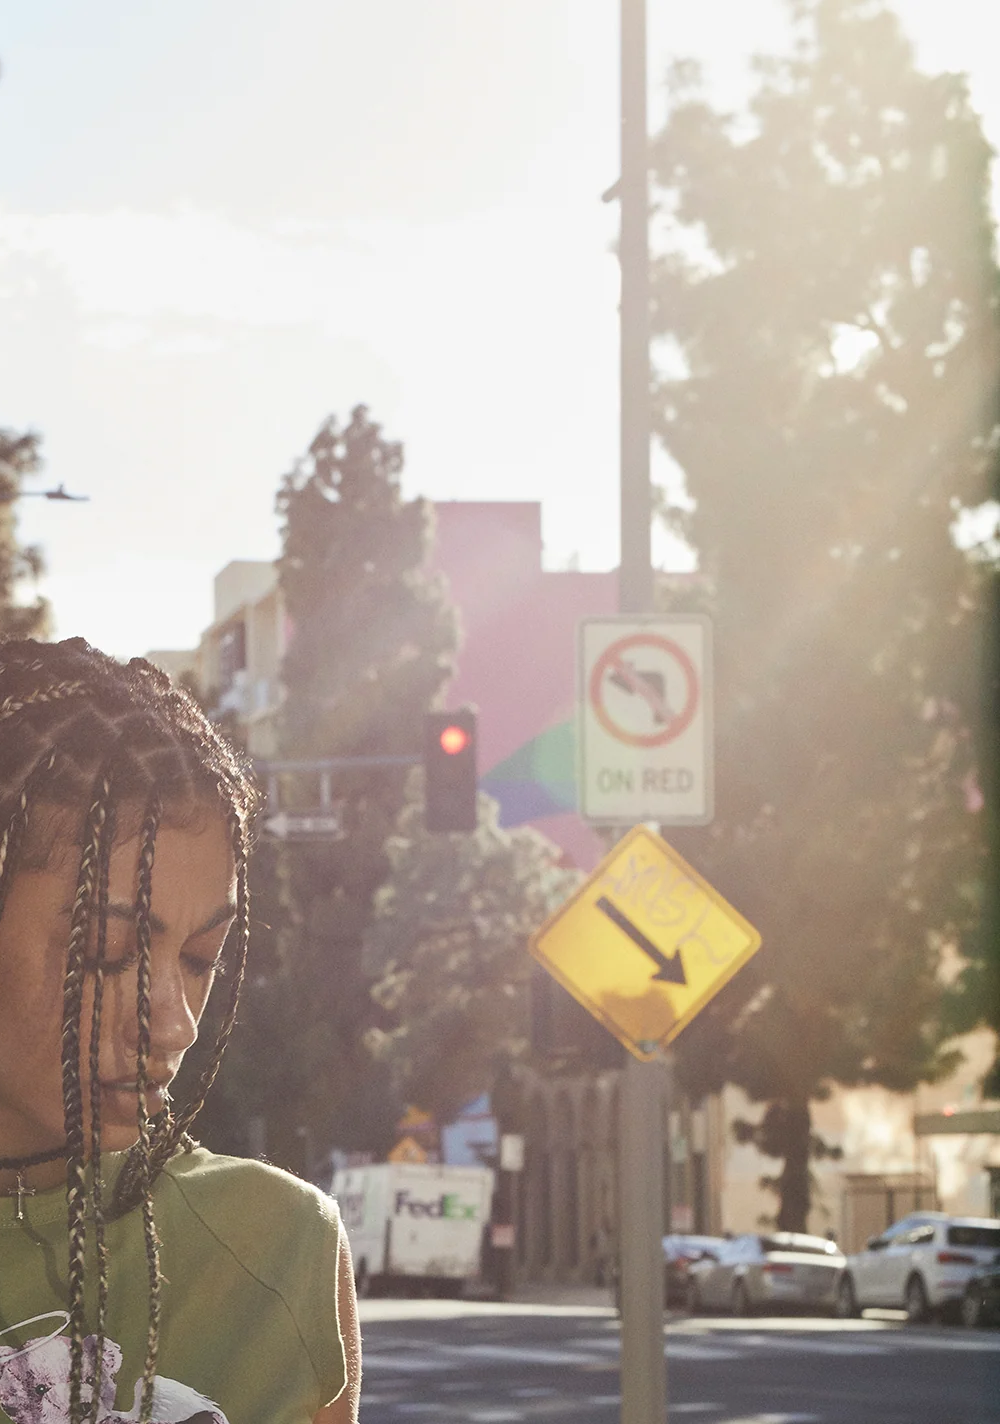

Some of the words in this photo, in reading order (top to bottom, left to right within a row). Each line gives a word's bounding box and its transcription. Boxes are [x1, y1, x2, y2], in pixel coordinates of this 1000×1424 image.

[597, 767, 634, 794] ON
[641, 767, 695, 794] RED
[395, 1190, 480, 1220] FedEx
